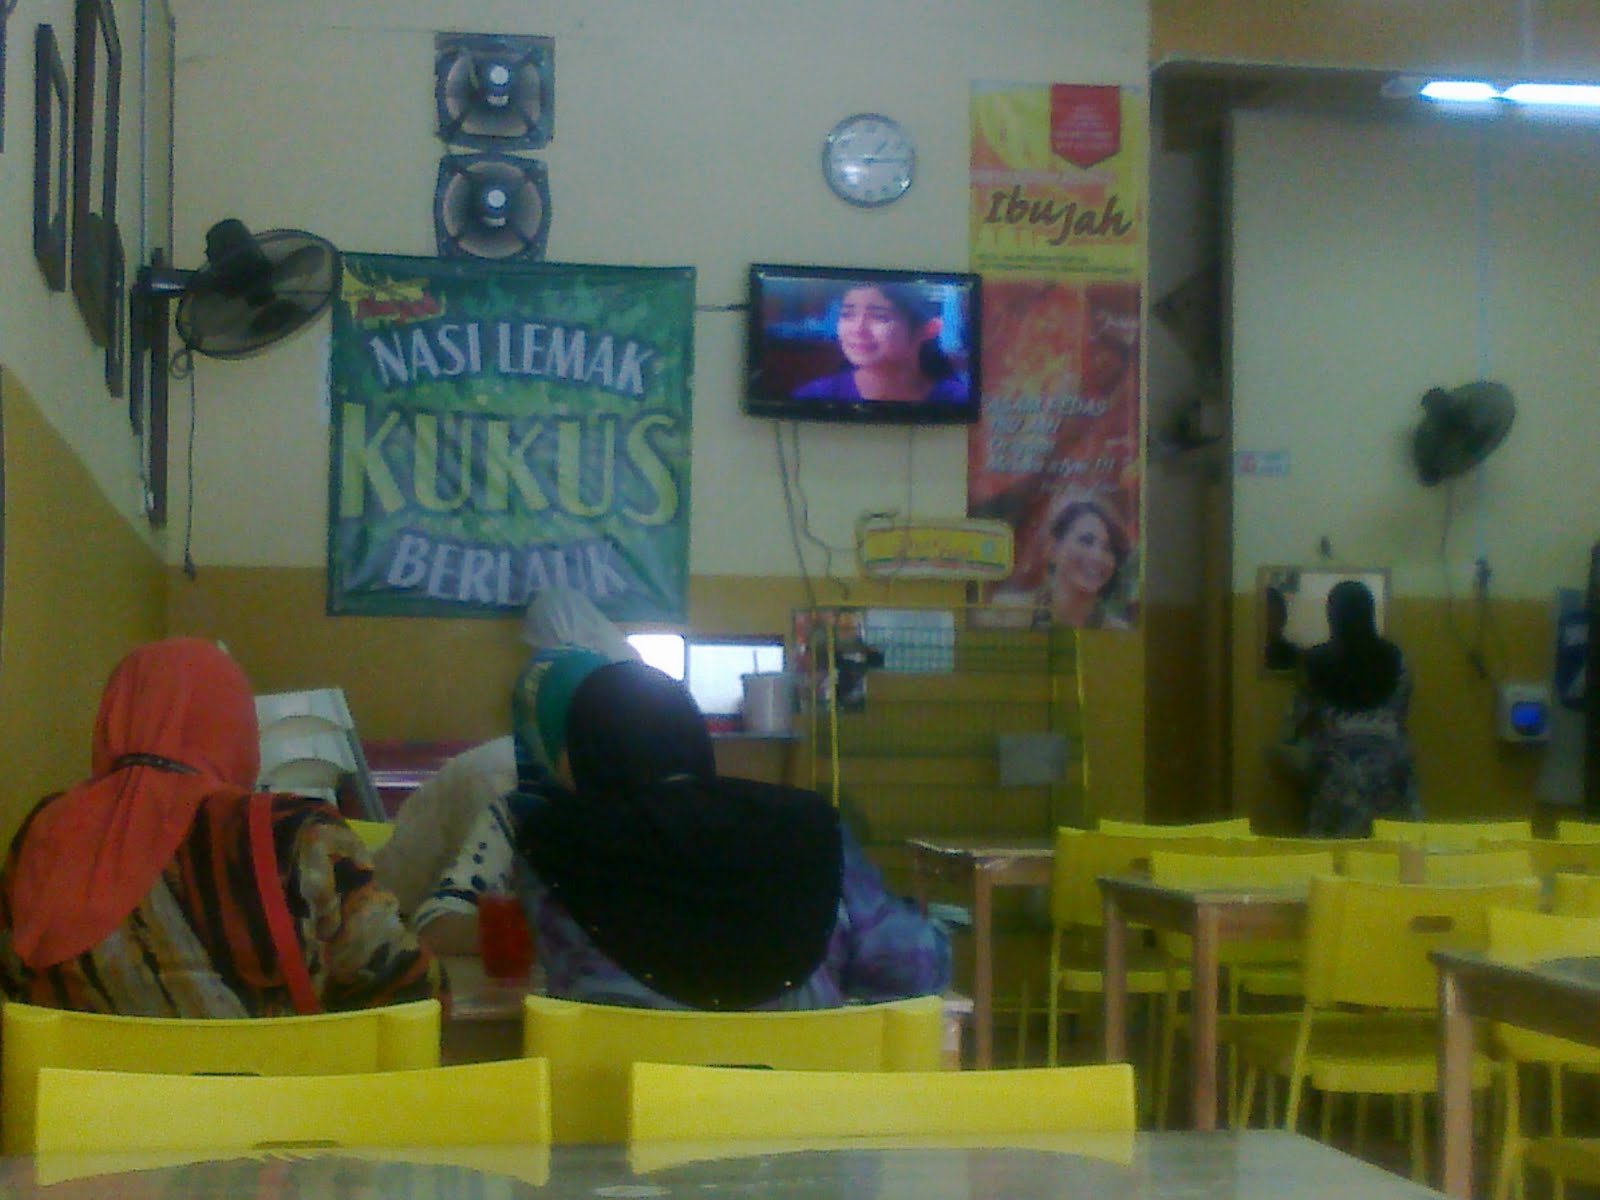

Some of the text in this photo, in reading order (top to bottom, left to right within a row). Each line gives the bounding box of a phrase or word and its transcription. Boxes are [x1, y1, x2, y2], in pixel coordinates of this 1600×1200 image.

[983, 183, 1132, 246] Ibujah
[369, 321, 650, 396] NASI LEMAK
[339, 402, 678, 526] KUKUS
